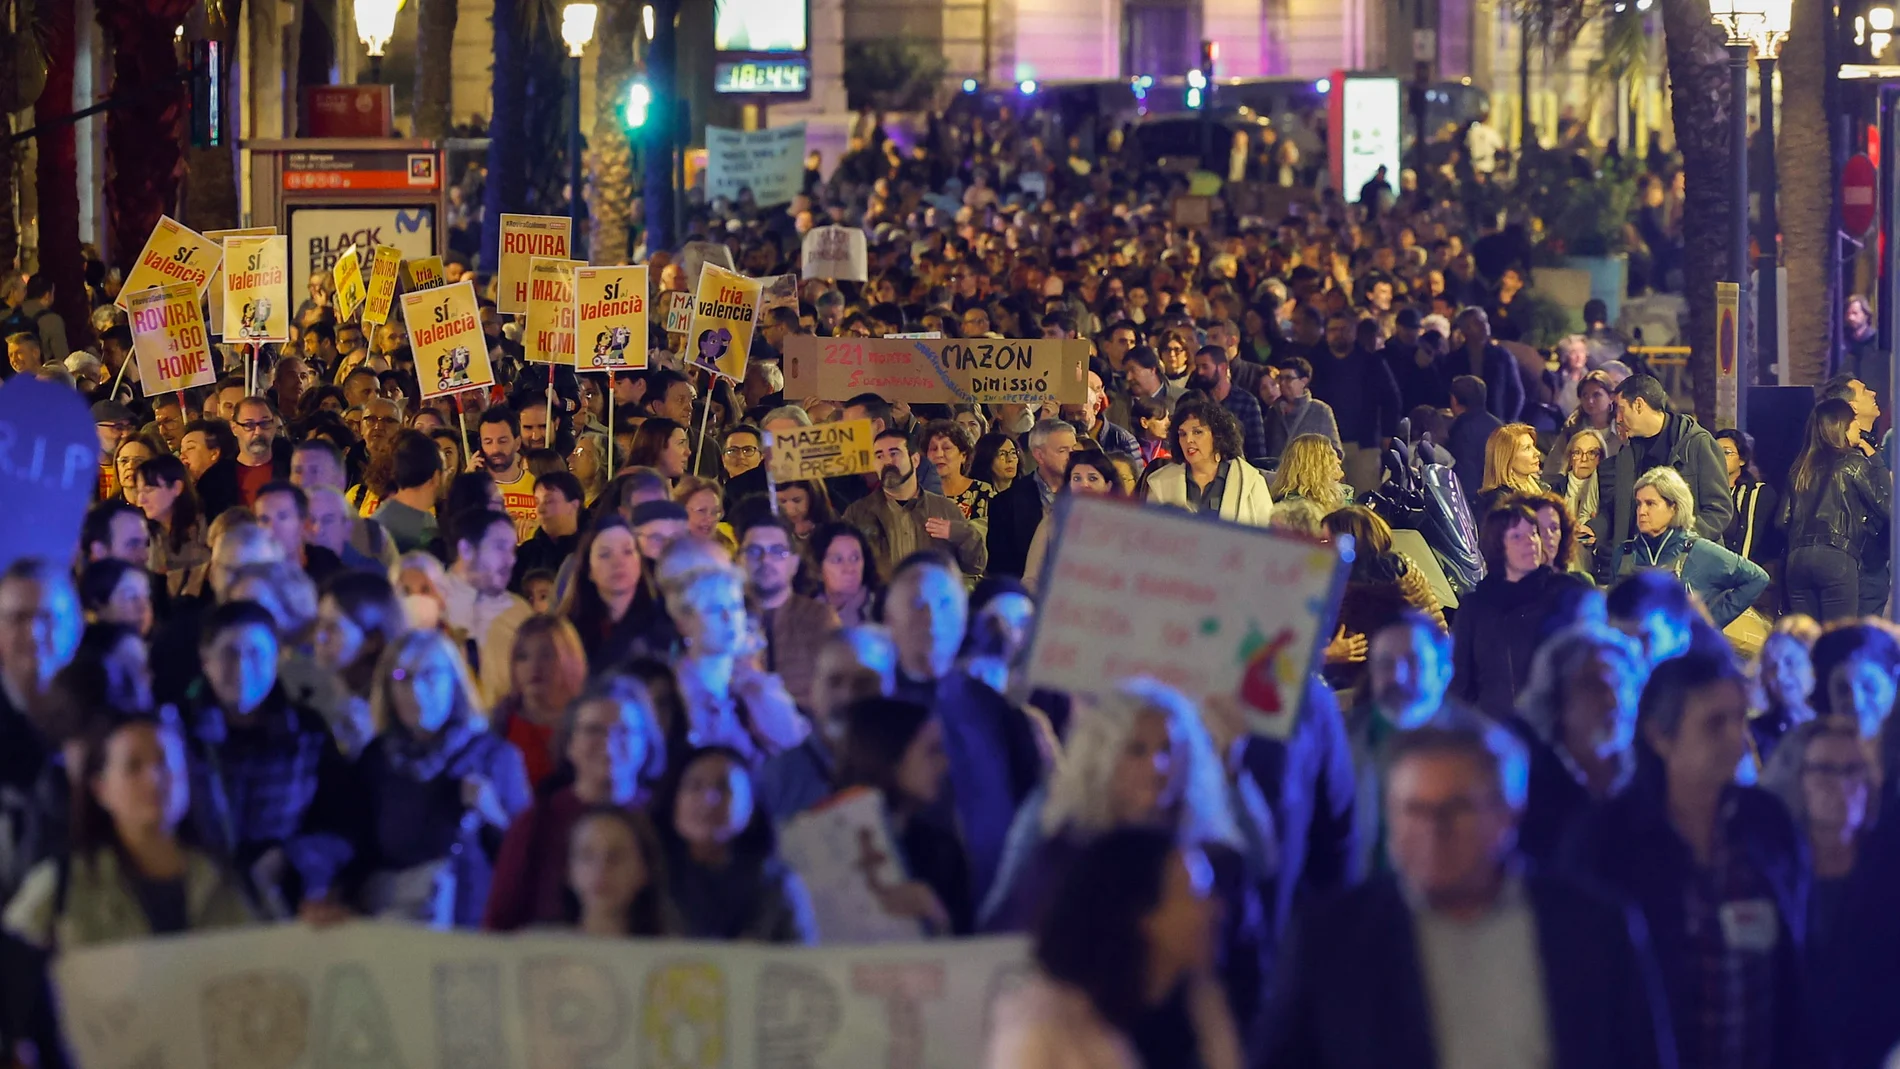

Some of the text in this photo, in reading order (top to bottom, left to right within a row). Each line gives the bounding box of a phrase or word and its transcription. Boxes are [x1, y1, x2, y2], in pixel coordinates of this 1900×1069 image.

[730, 65, 801, 89] 18:44
[310, 227, 380, 254] BLACK
[504, 232, 565, 256] ROVIRA
[229, 266, 282, 291] Valencià
[374, 259, 397, 278] ROVIRA
[416, 266, 433, 283] tria
[416, 274, 444, 291] lencià
[532, 278, 575, 303] MAZÓ
[673, 294, 697, 310] MA
[720, 286, 743, 304] tria
[133, 301, 198, 333] ROVIRA
[581, 295, 643, 320] Valencià
[699, 299, 753, 322] valencià
[415, 311, 475, 347] Valencià
[157, 351, 208, 380] HOME
[824, 344, 863, 366] 221
[941, 342, 1032, 371] MAZÓN
